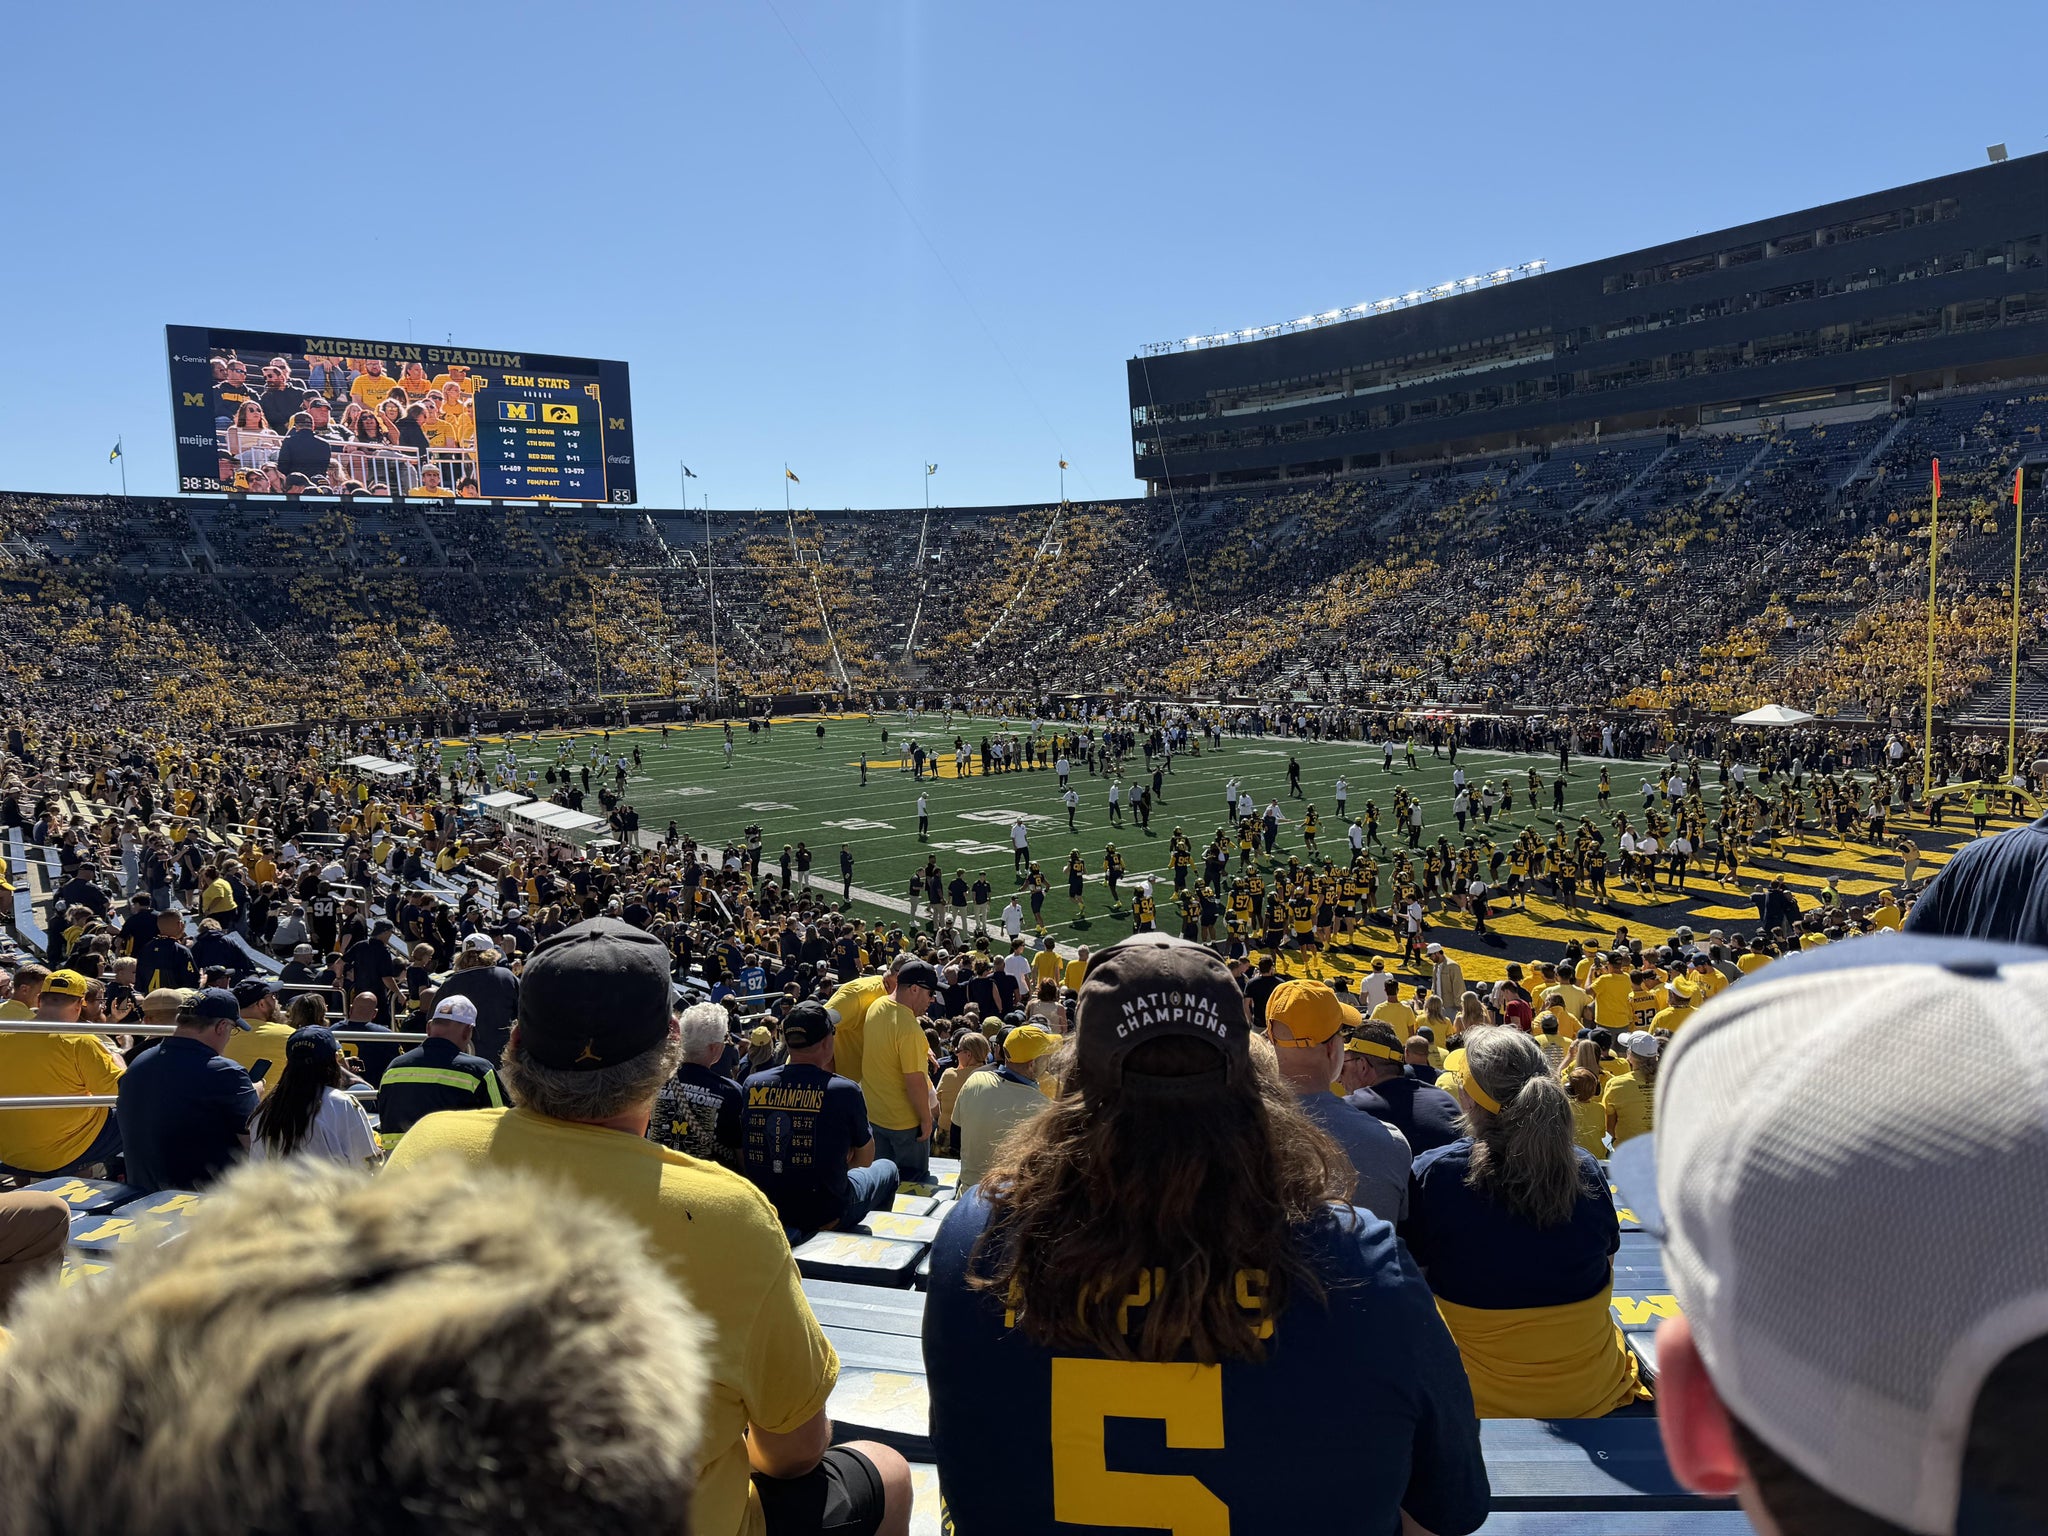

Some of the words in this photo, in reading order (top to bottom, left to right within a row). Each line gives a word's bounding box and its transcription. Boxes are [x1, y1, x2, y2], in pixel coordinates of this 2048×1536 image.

[182, 355, 207, 364] Gemini
[306, 339, 422, 361] MICHIGAN
[428, 348, 521, 368] STADIUM
[503, 375, 534, 387] TEAM
[537, 377, 570, 389] STATS
[183, 392, 205, 407] M
[507, 403, 528, 419] M
[609, 418, 625, 430] M
[179, 435, 214, 447] meijer
[182, 477, 220, 490] 38:36
[1562, 866, 1576, 877] 32
[313, 901, 334, 917] 94
[1294, 907, 1308, 918] 97
[187, 961, 194, 973] 4
[748, 976, 763, 991] 97
[1122, 991, 1219, 1017] NATIONAL
[1116, 1008, 1227, 1038] CHAMPIONS
[1634, 1008, 1656, 1026] 32
[748, 1087, 769, 1105] M
[768, 1088, 824, 1109] CHAMPIONS
[671, 1120, 688, 1135] M
